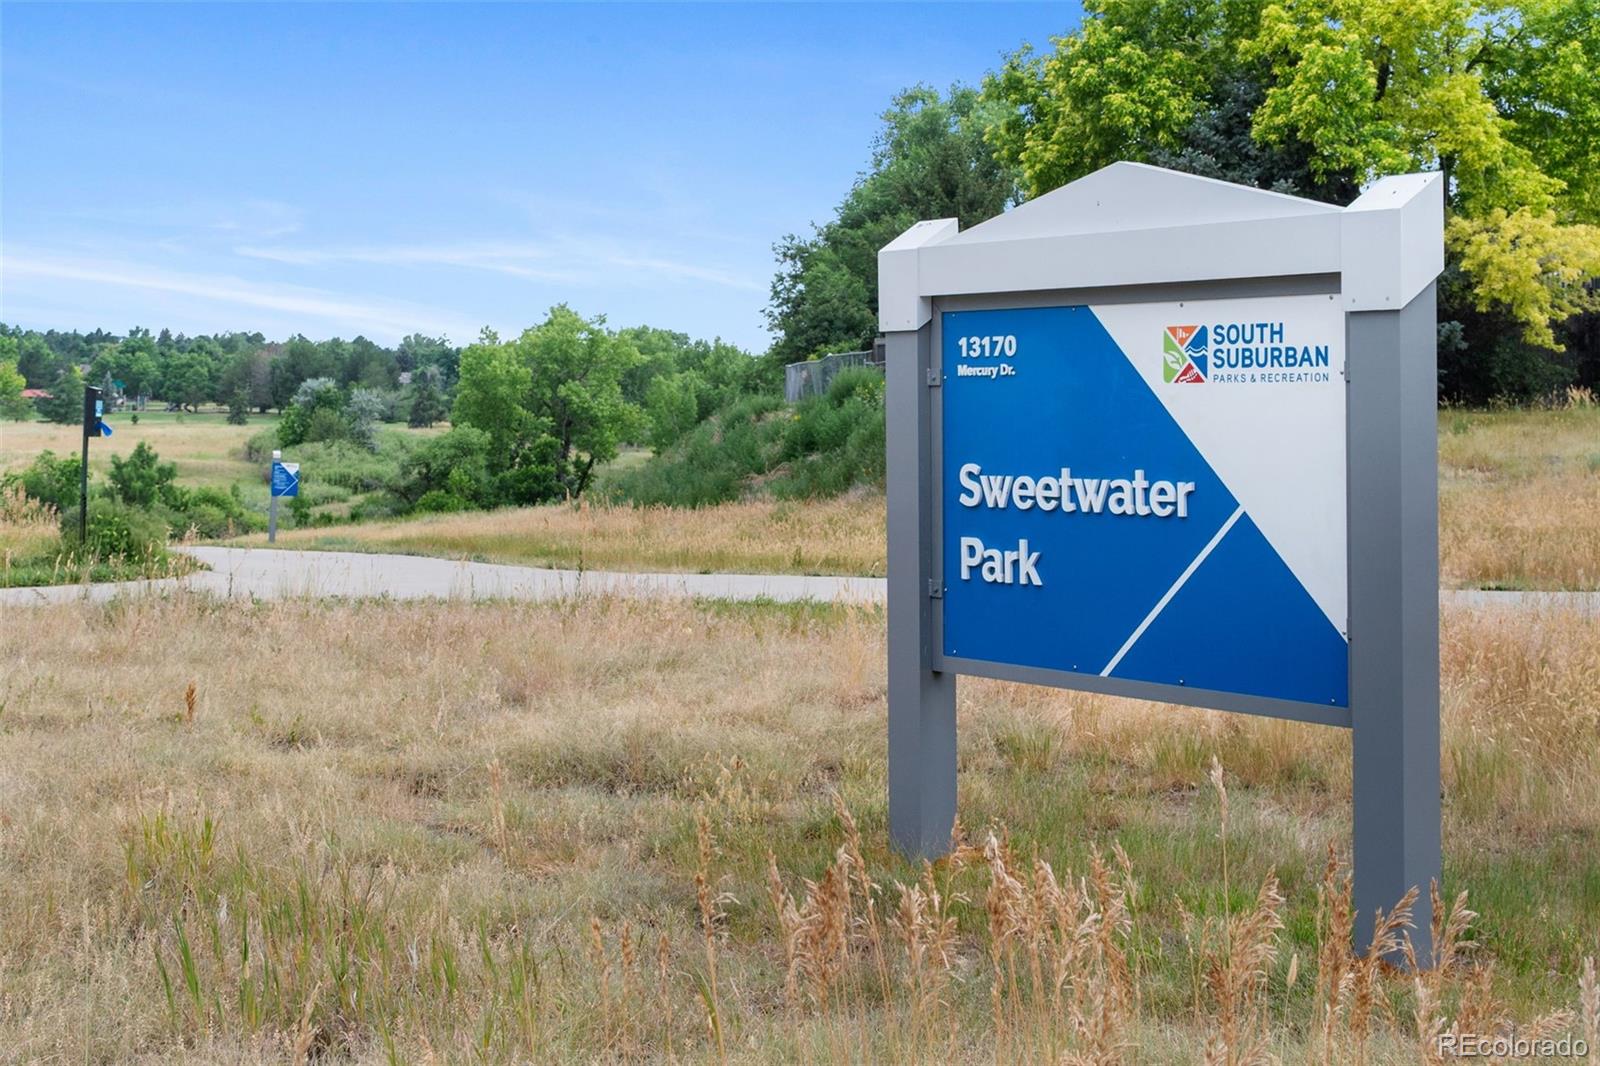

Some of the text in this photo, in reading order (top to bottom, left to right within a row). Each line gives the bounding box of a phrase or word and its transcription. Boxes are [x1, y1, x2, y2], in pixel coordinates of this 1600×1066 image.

[1213, 322, 1283, 345] SOUTH
[958, 335, 1017, 358] 13170
[1213, 345, 1329, 369] SUBURBAN
[957, 363, 1016, 379] Mercury Dr.
[1213, 372, 1329, 383] PARKS & RECREATION
[959, 463, 1195, 518] Sweetwater
[960, 536, 1043, 586] Park
